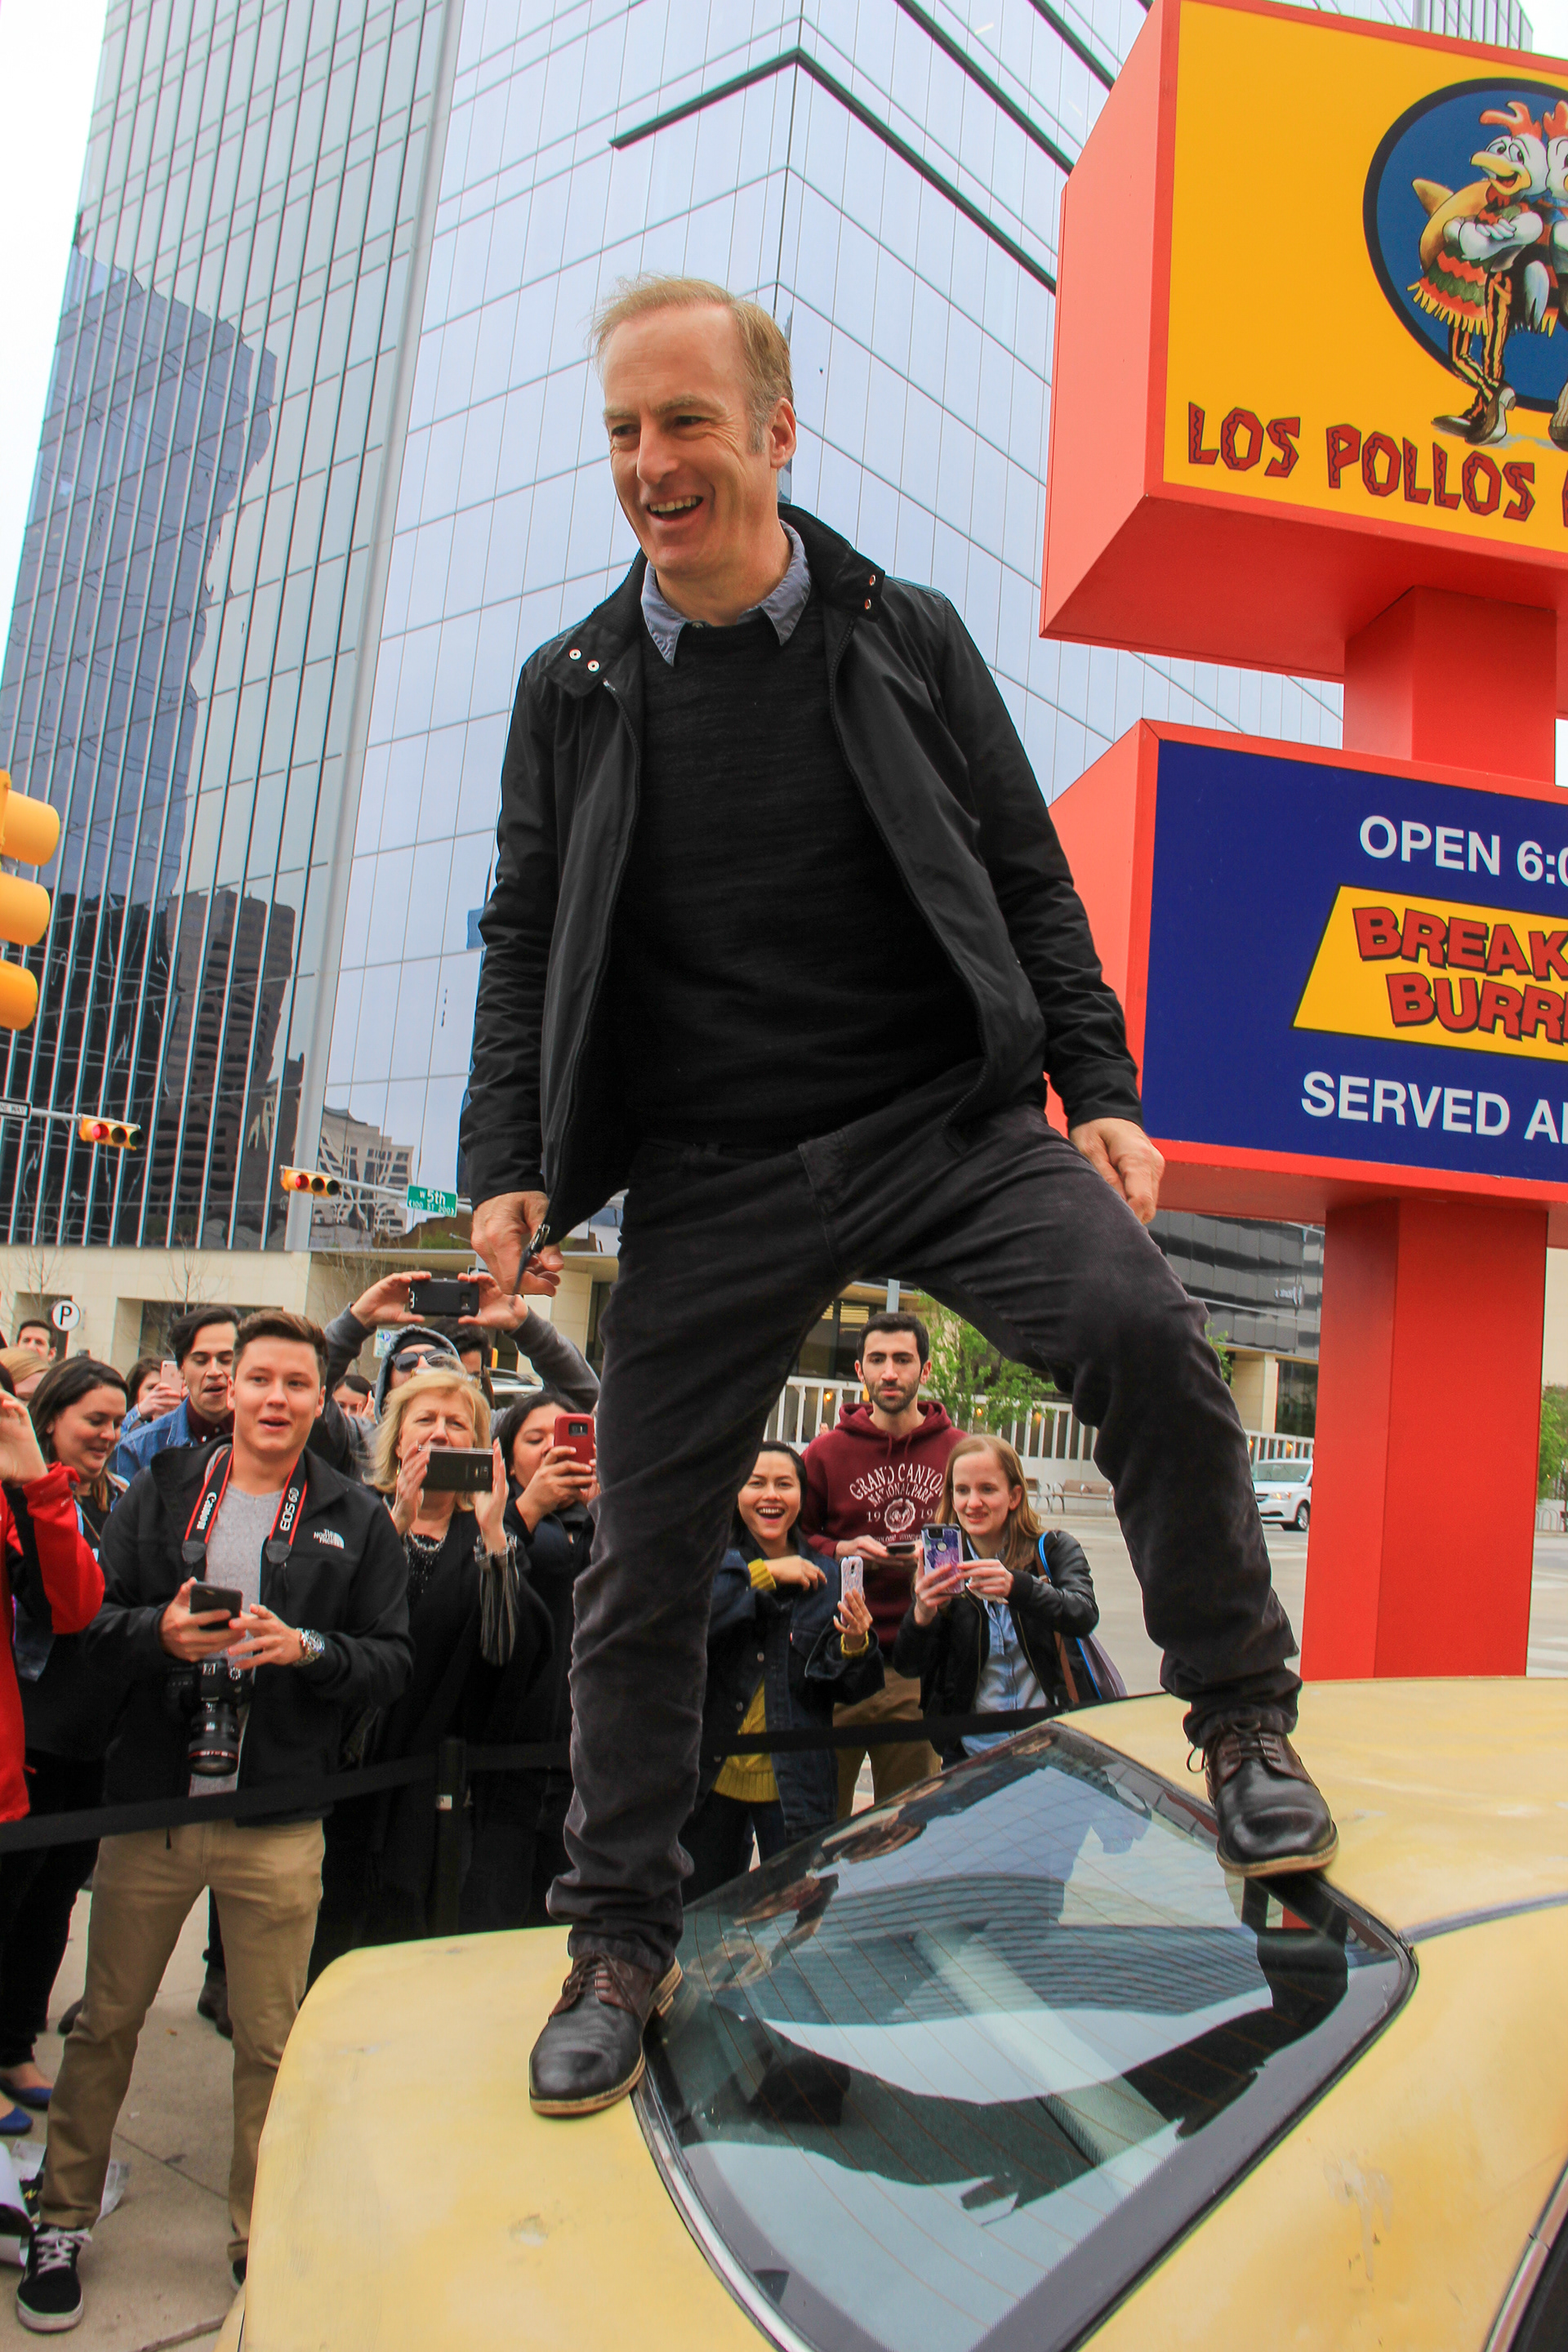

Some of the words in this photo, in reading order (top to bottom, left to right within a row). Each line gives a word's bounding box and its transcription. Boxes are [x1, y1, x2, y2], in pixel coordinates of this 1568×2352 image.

[1188, 401, 1301, 479] LOS
[1326, 424, 1535, 523] POLLOS
[1359, 815, 1500, 876] OPEN
[1352, 906, 1568, 982] BREAK
[1301, 1071, 1511, 1137] SERVED
[427, 1189, 446, 1206] 5th
[60, 1305, 73, 1325] P
[849, 1465, 895, 1500] GRAND
[867, 1482, 910, 1508] NATIONAL
[911, 1483, 934, 1504] PARK
[279, 1502, 296, 1532] EOS
[867, 1511, 881, 1523] 19
[920, 1508, 933, 1520] 19
